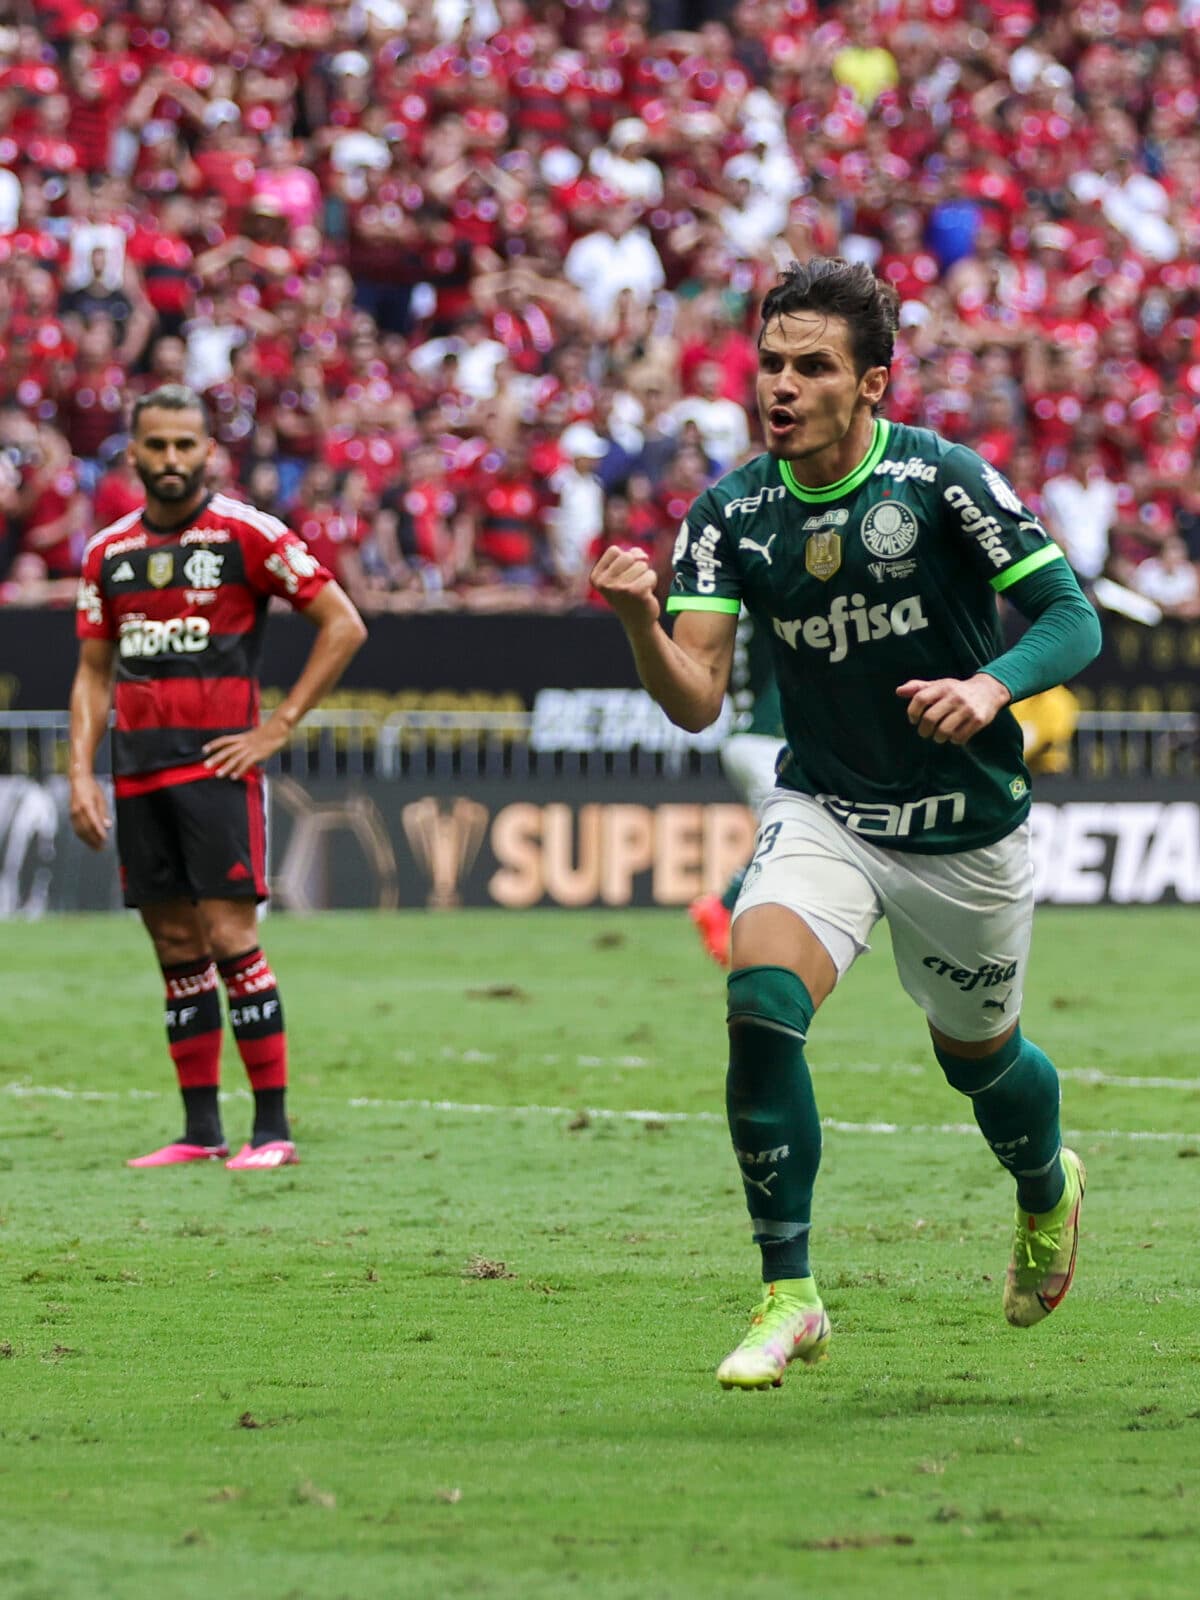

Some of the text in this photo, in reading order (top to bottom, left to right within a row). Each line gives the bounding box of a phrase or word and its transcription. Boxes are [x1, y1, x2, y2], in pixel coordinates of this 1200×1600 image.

[865, 522, 914, 555] PALMEIRAS
[943, 485, 1012, 568] crefisa
[488, 801, 757, 908] SUPER
[922, 956, 1018, 991] crefisa
[165, 1006, 199, 1028] RF
